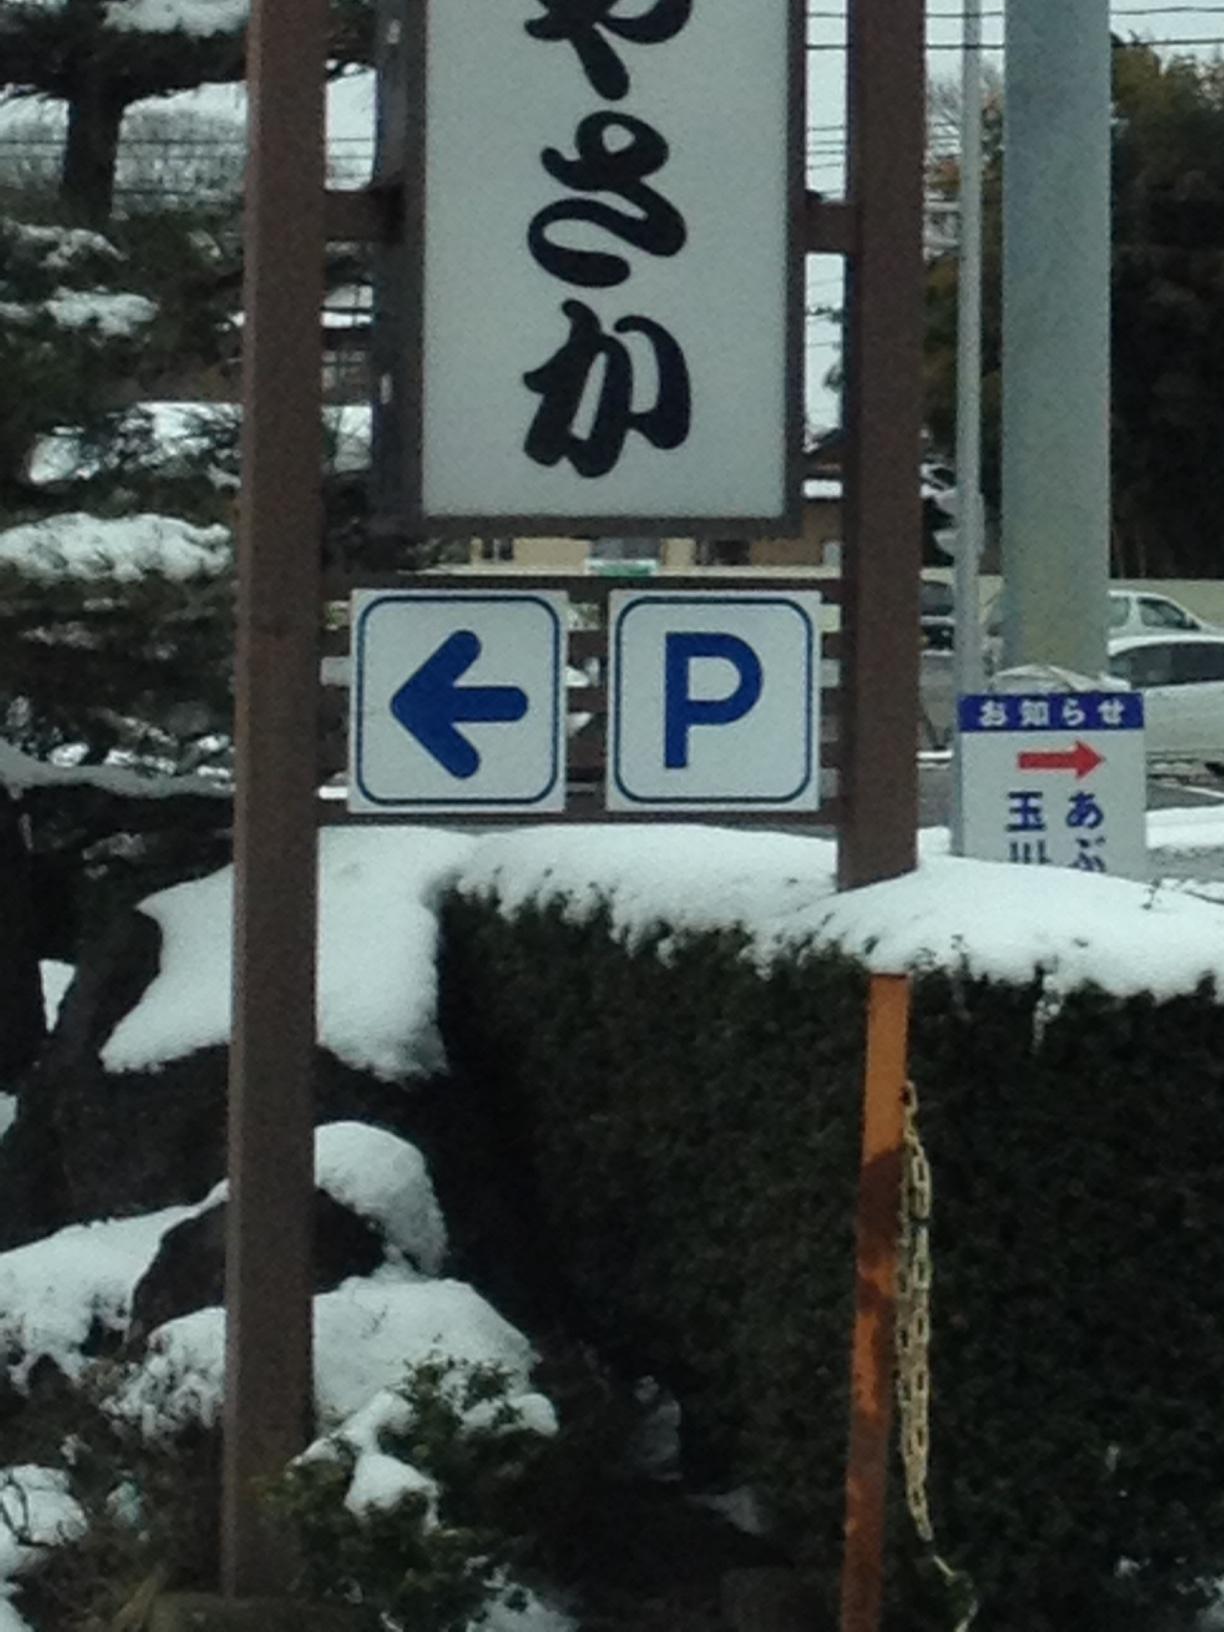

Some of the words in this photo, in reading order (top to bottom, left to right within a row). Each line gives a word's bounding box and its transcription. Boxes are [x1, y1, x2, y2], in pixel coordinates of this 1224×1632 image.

[663, 631, 764, 770] P
[978, 698, 1126, 727] お知らせ
